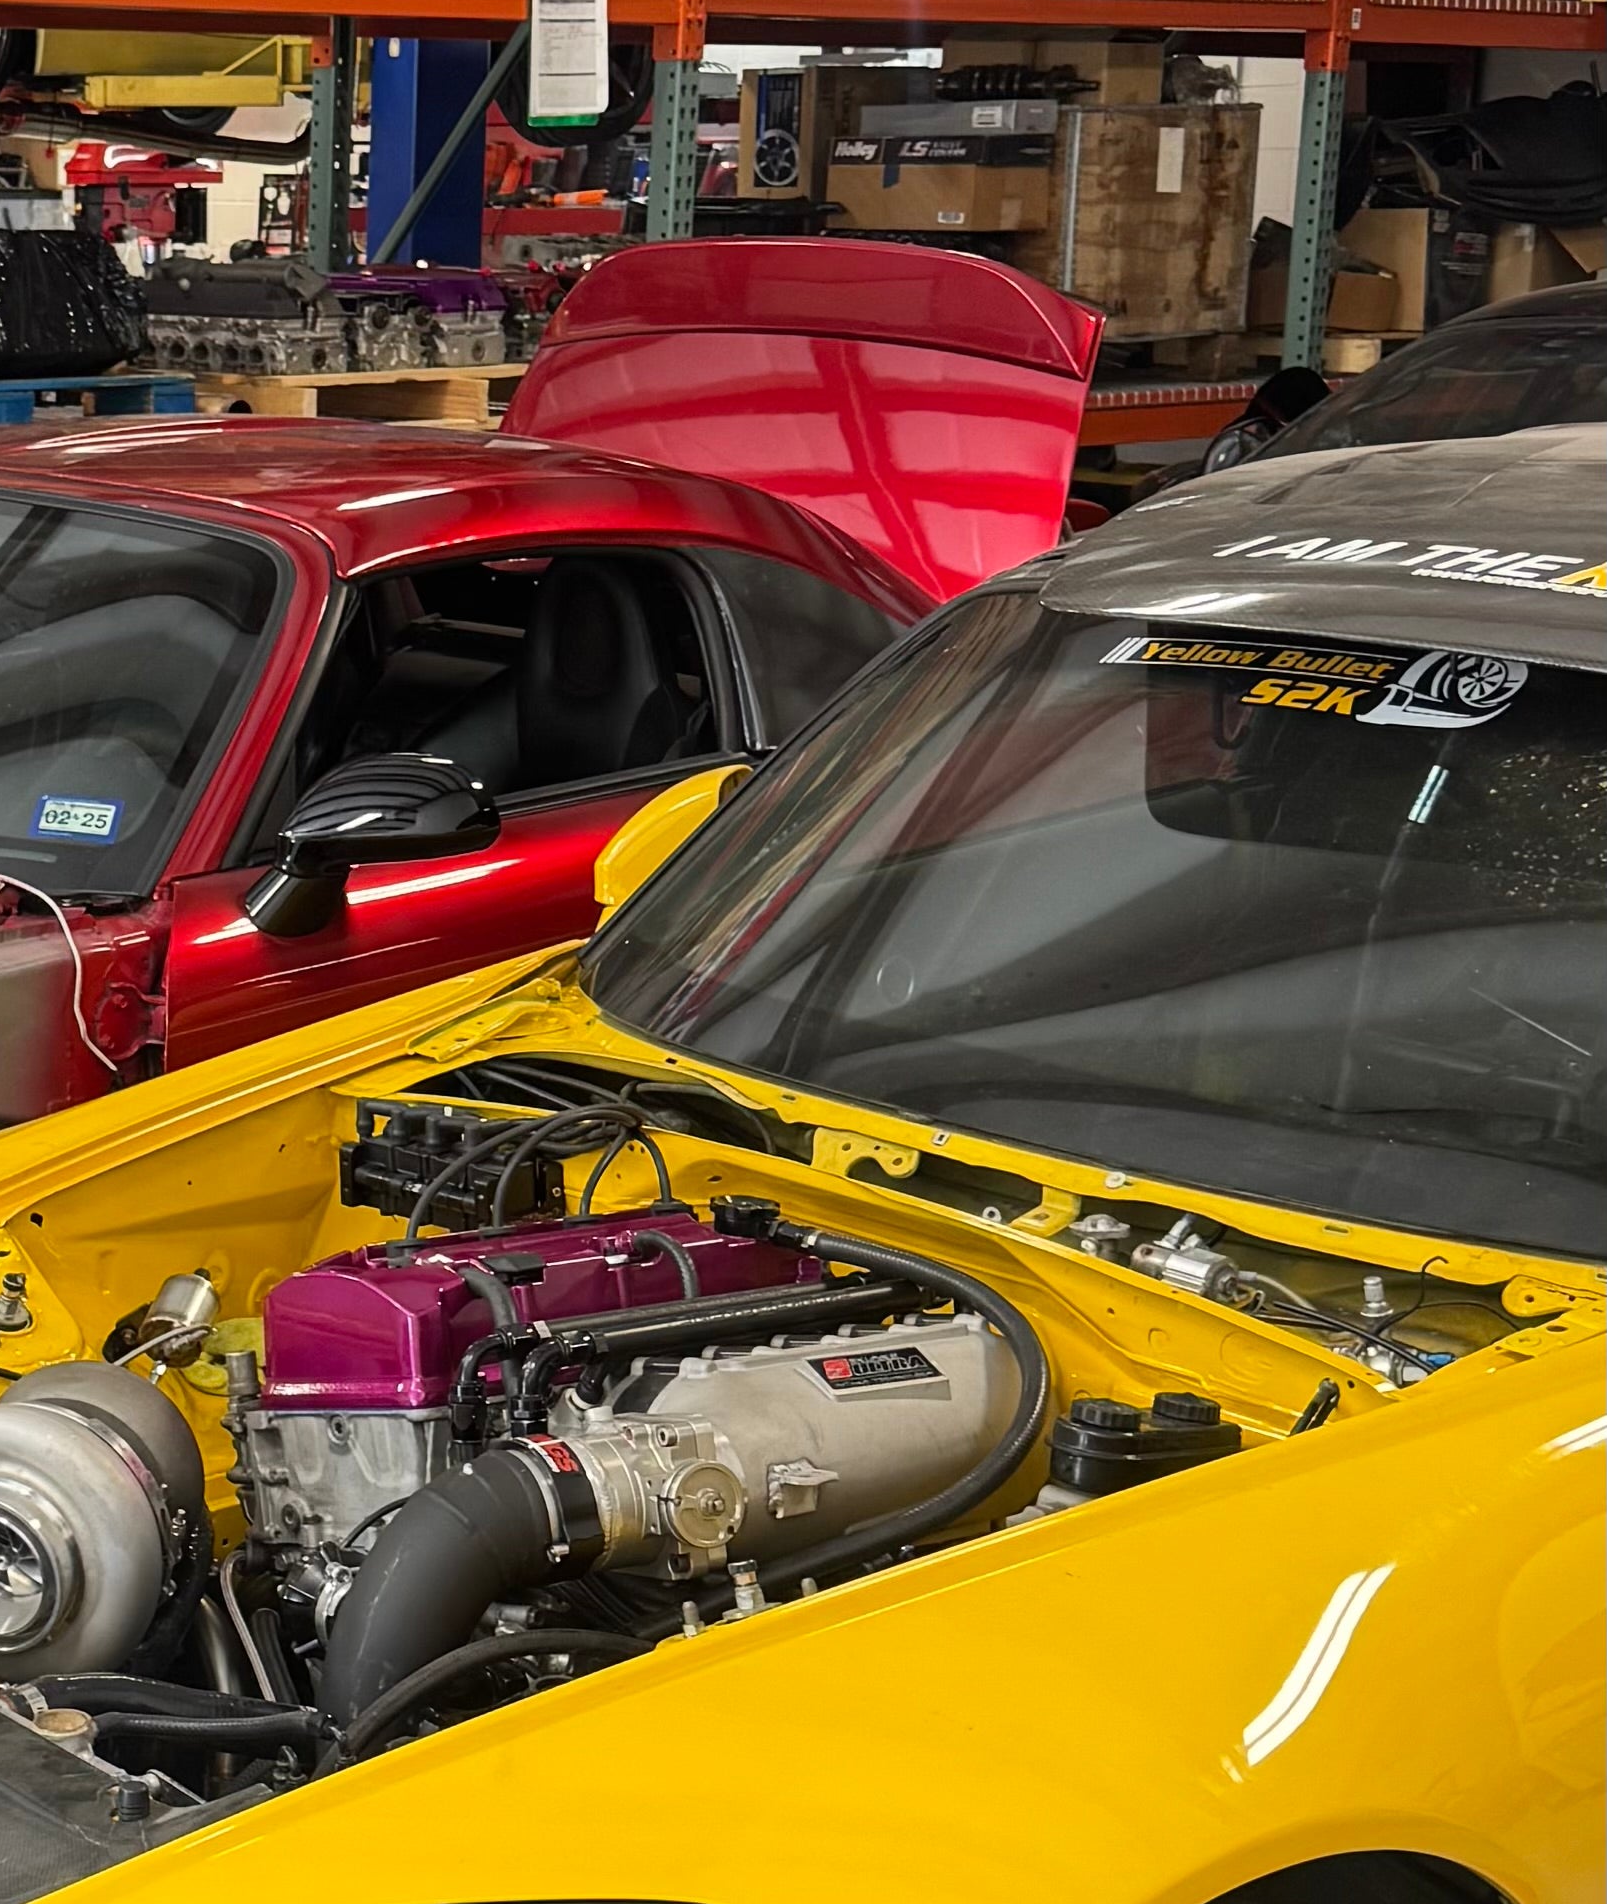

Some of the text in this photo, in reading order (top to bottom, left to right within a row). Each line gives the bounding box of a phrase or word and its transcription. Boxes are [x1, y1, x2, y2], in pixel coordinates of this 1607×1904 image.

[834, 140, 931, 161] Holley LS
[1212, 534, 1278, 558] I
[1245, 536, 1409, 563] AM
[1398, 543, 1585, 580] THE
[1140, 639, 1397, 681] Yellow Bullet
[1239, 678, 1372, 717] S2K
[80, 812, 109, 829] 25
